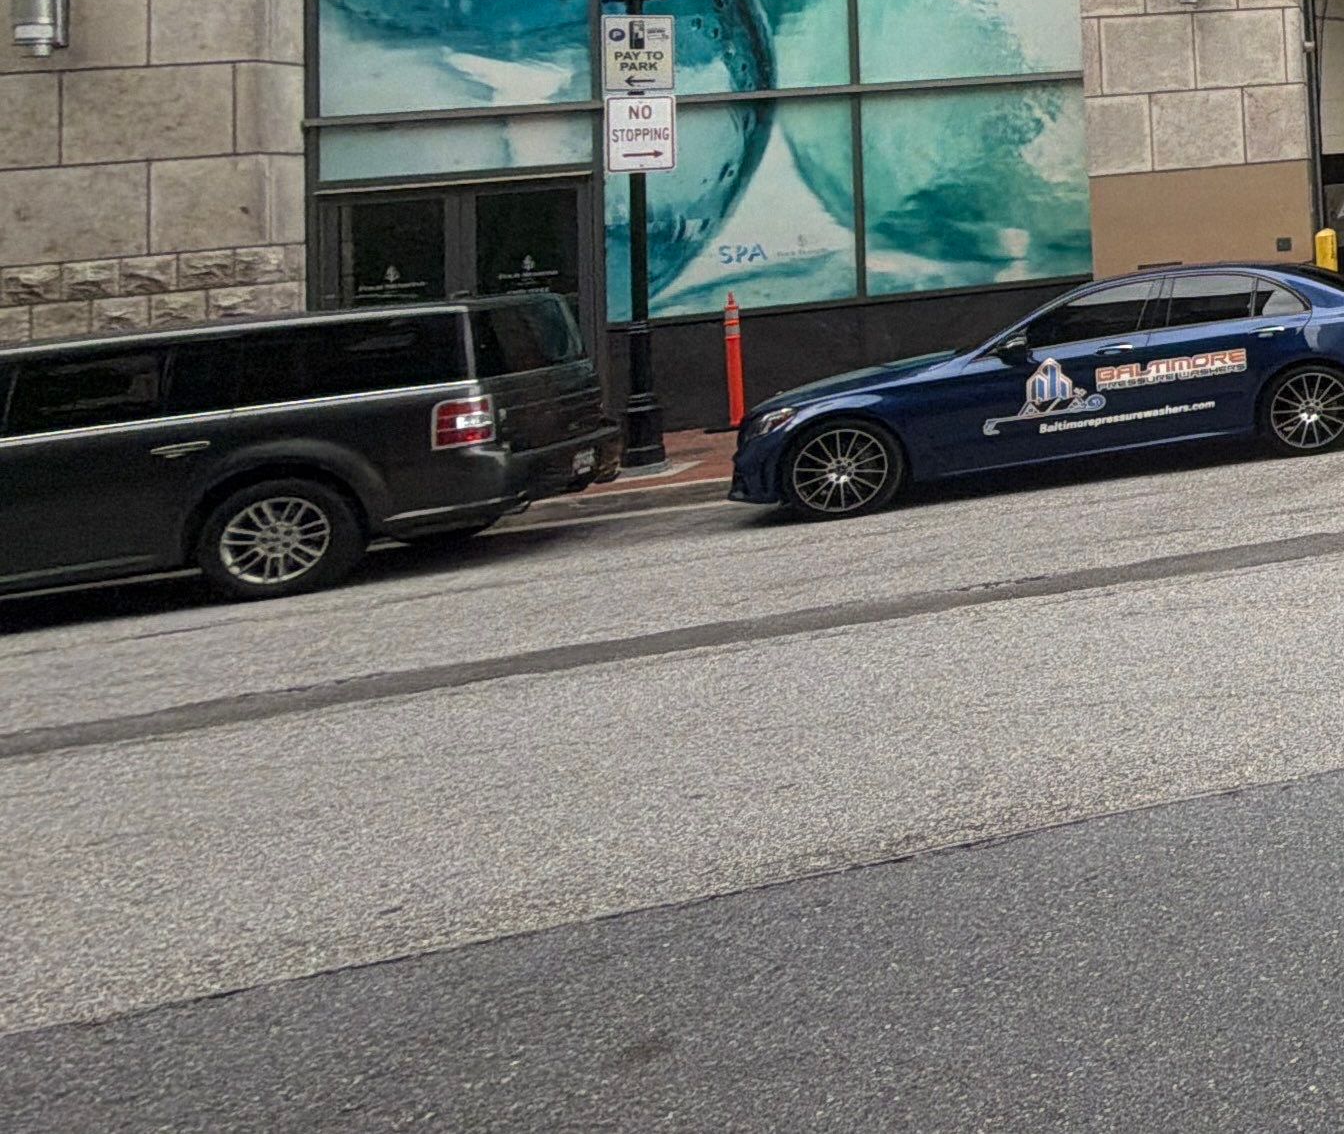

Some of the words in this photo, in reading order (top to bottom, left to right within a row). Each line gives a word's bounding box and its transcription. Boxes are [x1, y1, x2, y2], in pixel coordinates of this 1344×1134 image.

[614, 51, 640, 61] PAY
[644, 50, 664, 61] TO
[619, 62, 659, 72] PARK
[628, 105, 653, 120] NO
[611, 127, 670, 143] STOPPING
[719, 243, 768, 265] SPA
[1097, 349, 1246, 382] BALTIMORE
[1097, 375, 1174, 391] PRESSURE
[1178, 364, 1246, 380] WASHERS
[1039, 400, 1216, 434] Baltimorepressurewashers.com
